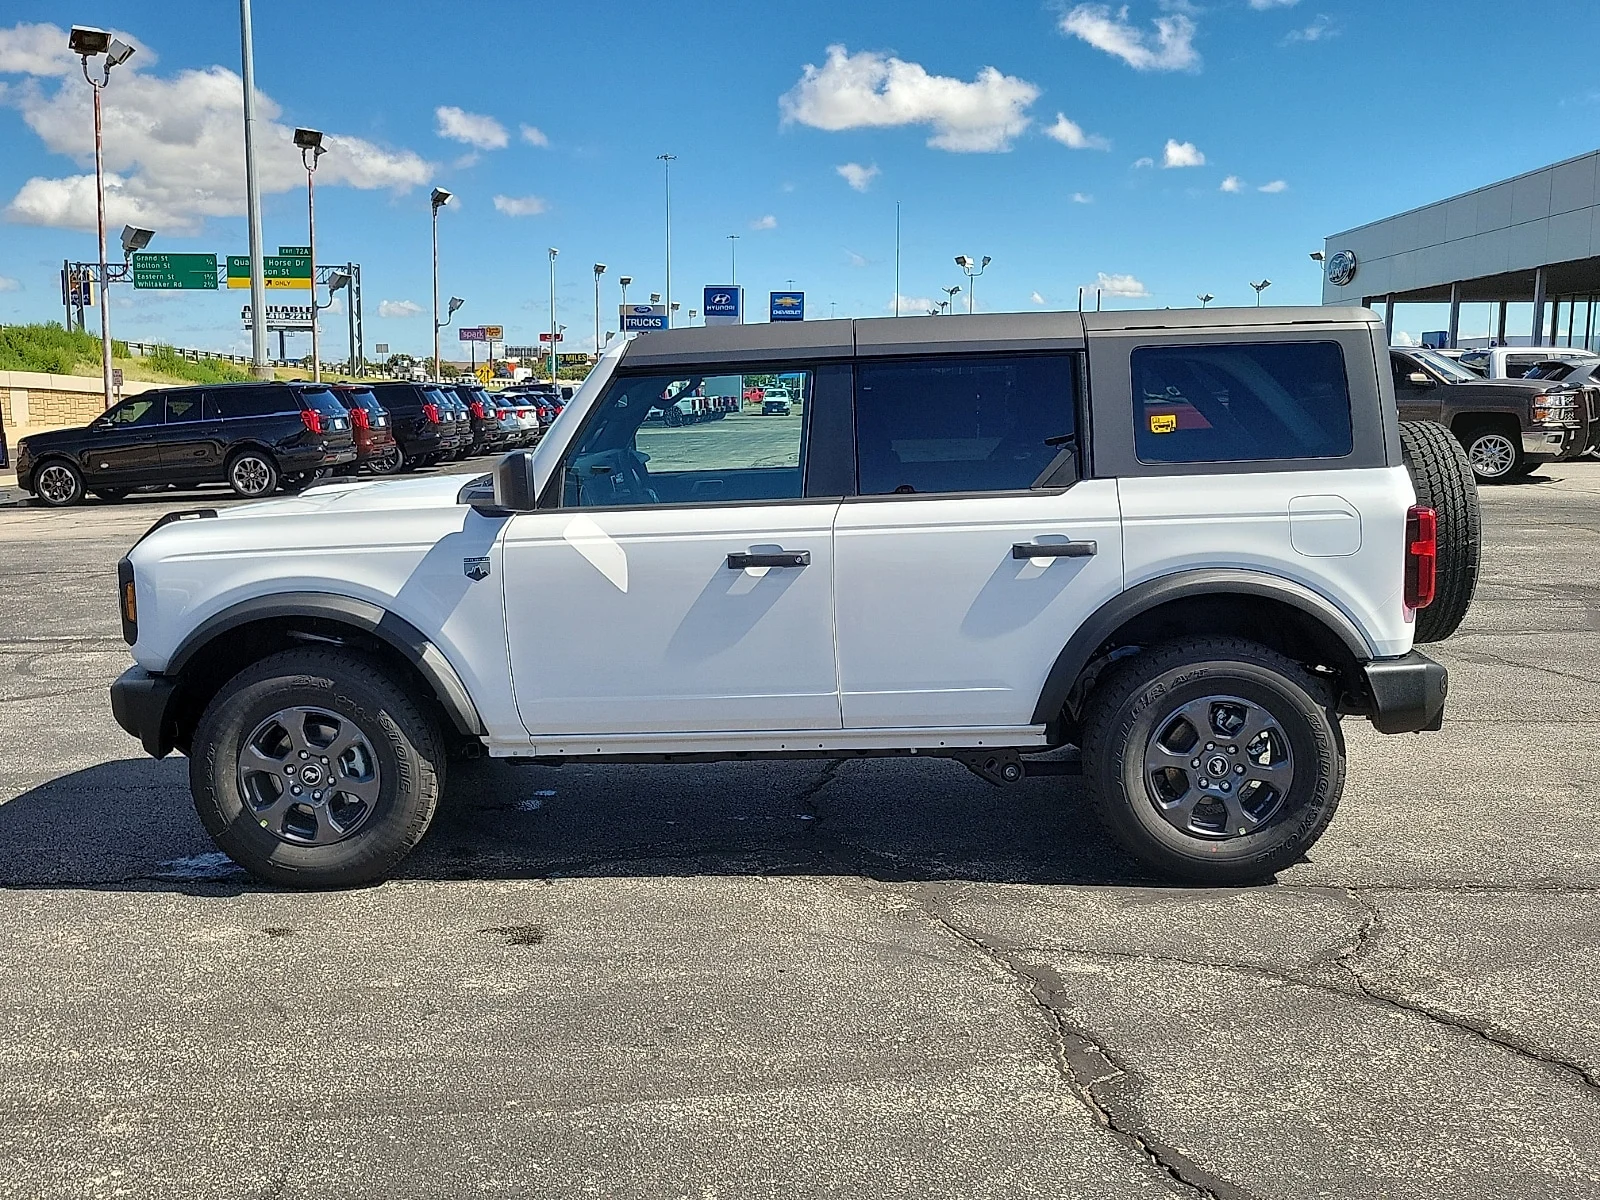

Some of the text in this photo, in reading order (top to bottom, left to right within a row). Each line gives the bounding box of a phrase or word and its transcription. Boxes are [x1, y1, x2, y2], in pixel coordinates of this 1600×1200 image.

[295, 247, 309, 255] 72A
[268, 259, 292, 267] Horse
[295, 259, 305, 267] Dr
[281, 268, 290, 276] St
[626, 318, 662, 327] TRUCKS
[463, 330, 484, 339] spark
[565, 354, 587, 362] MILES
